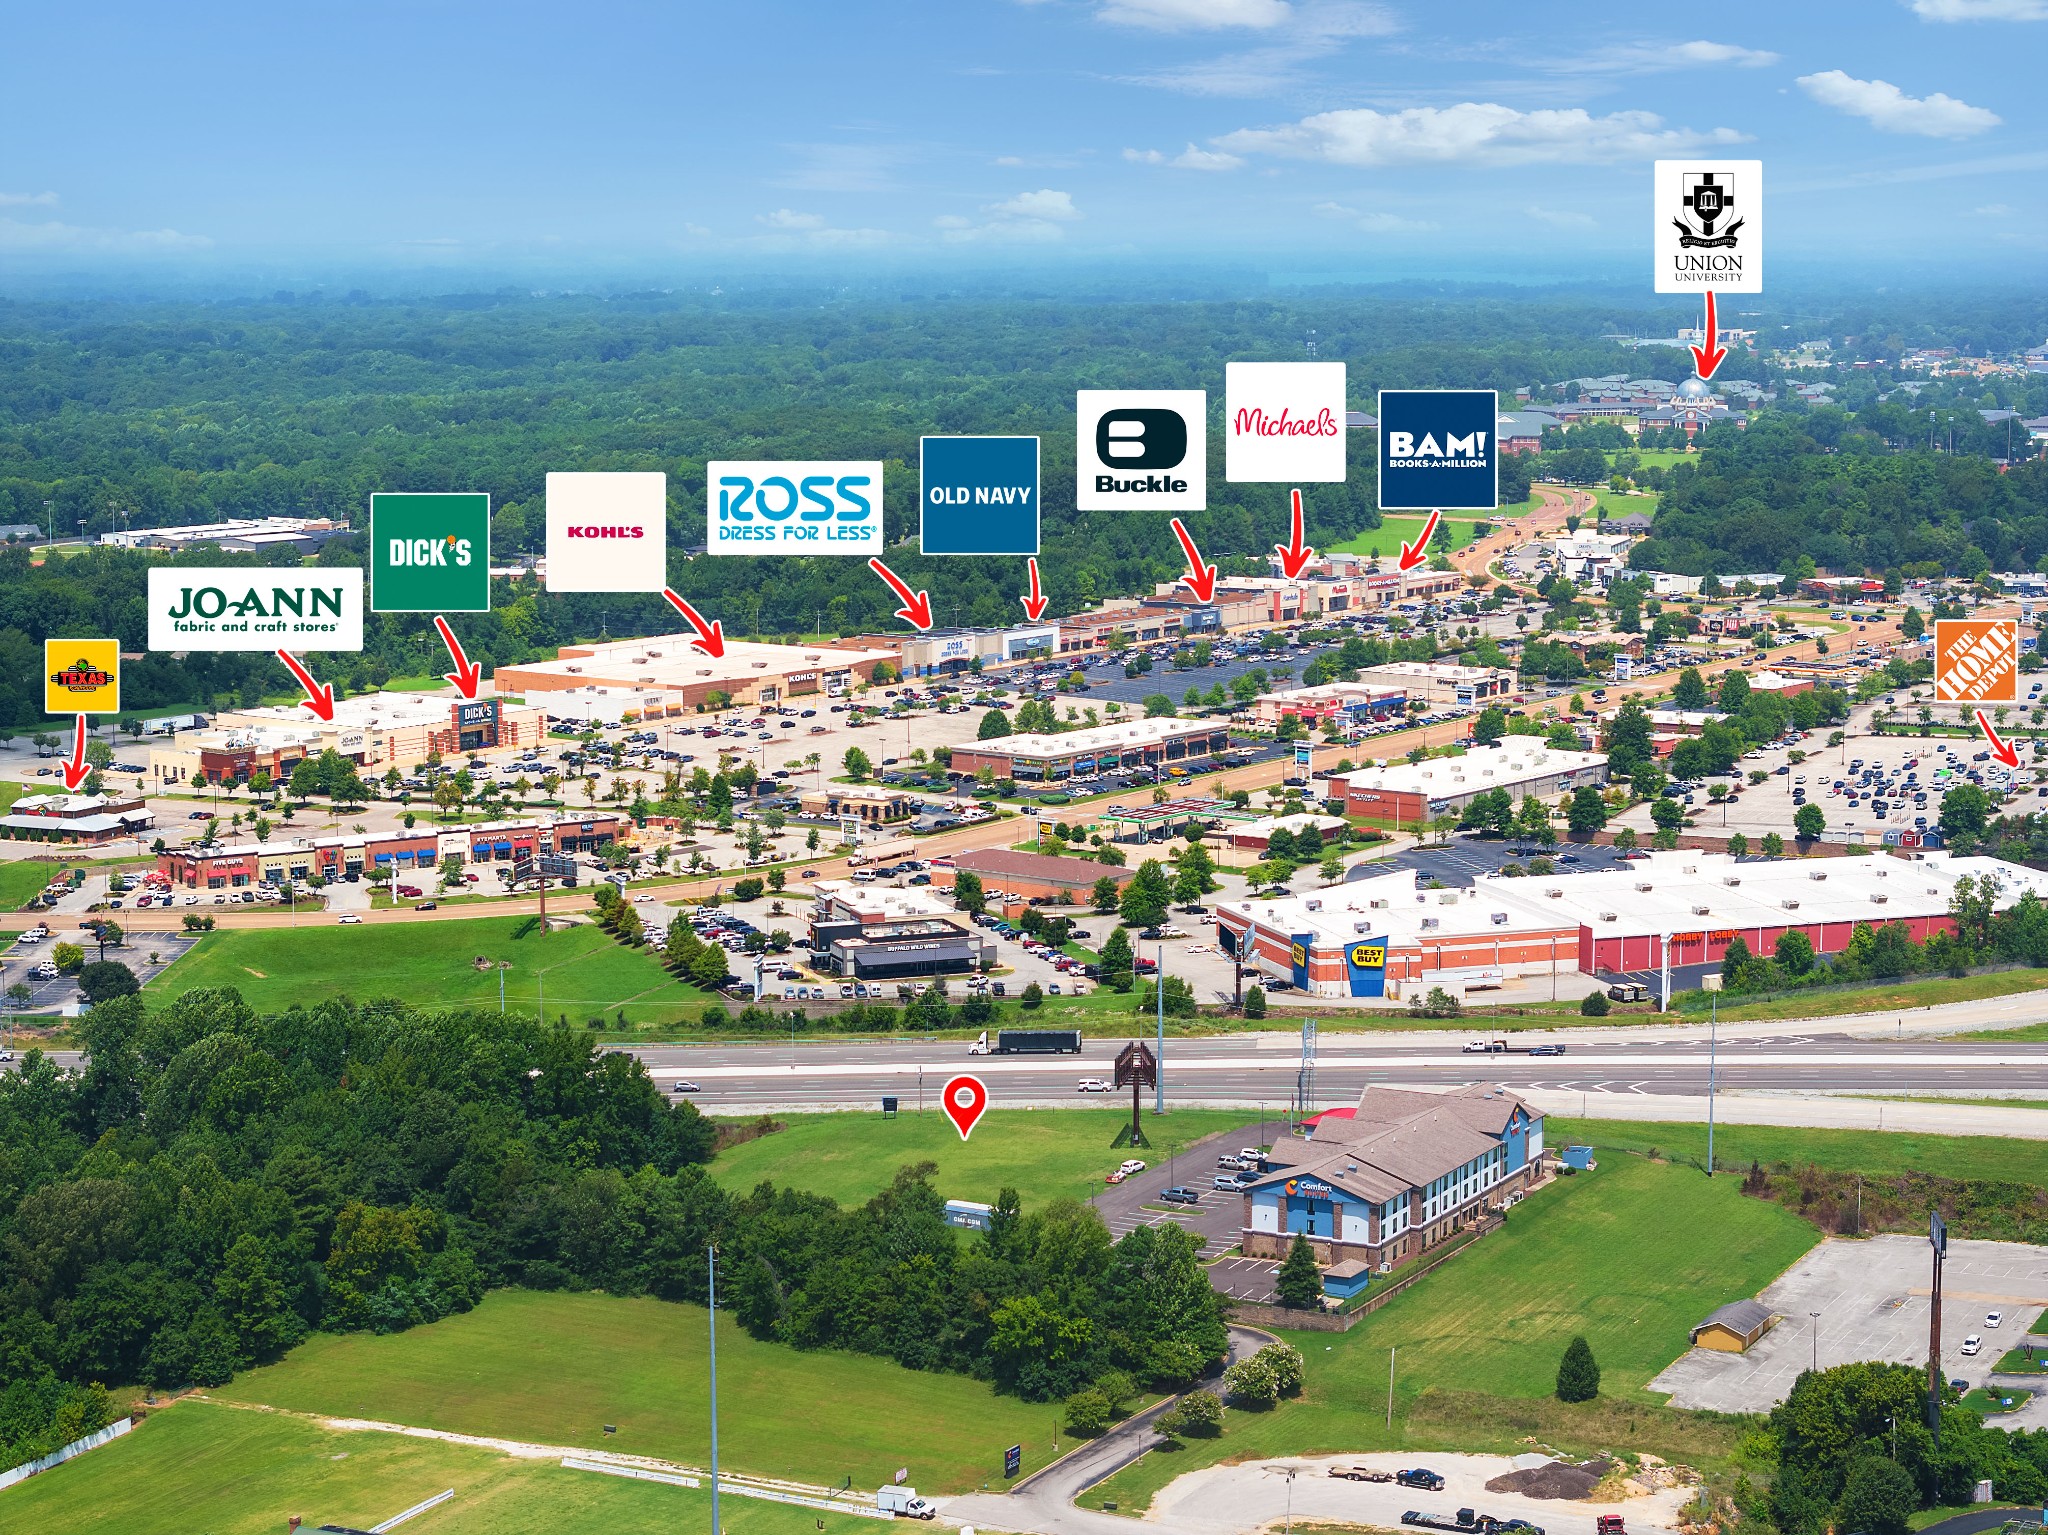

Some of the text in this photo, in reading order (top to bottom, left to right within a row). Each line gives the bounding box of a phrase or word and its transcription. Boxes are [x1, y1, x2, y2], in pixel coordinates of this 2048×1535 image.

[789, 672, 817, 682] KOHL'S
[464, 704, 492, 719] DICK'S
[1672, 930, 1739, 941] HOBBY LOBBY
[1356, 948, 1382, 956] BEST
[1300, 1181, 1332, 1191] Comfort
